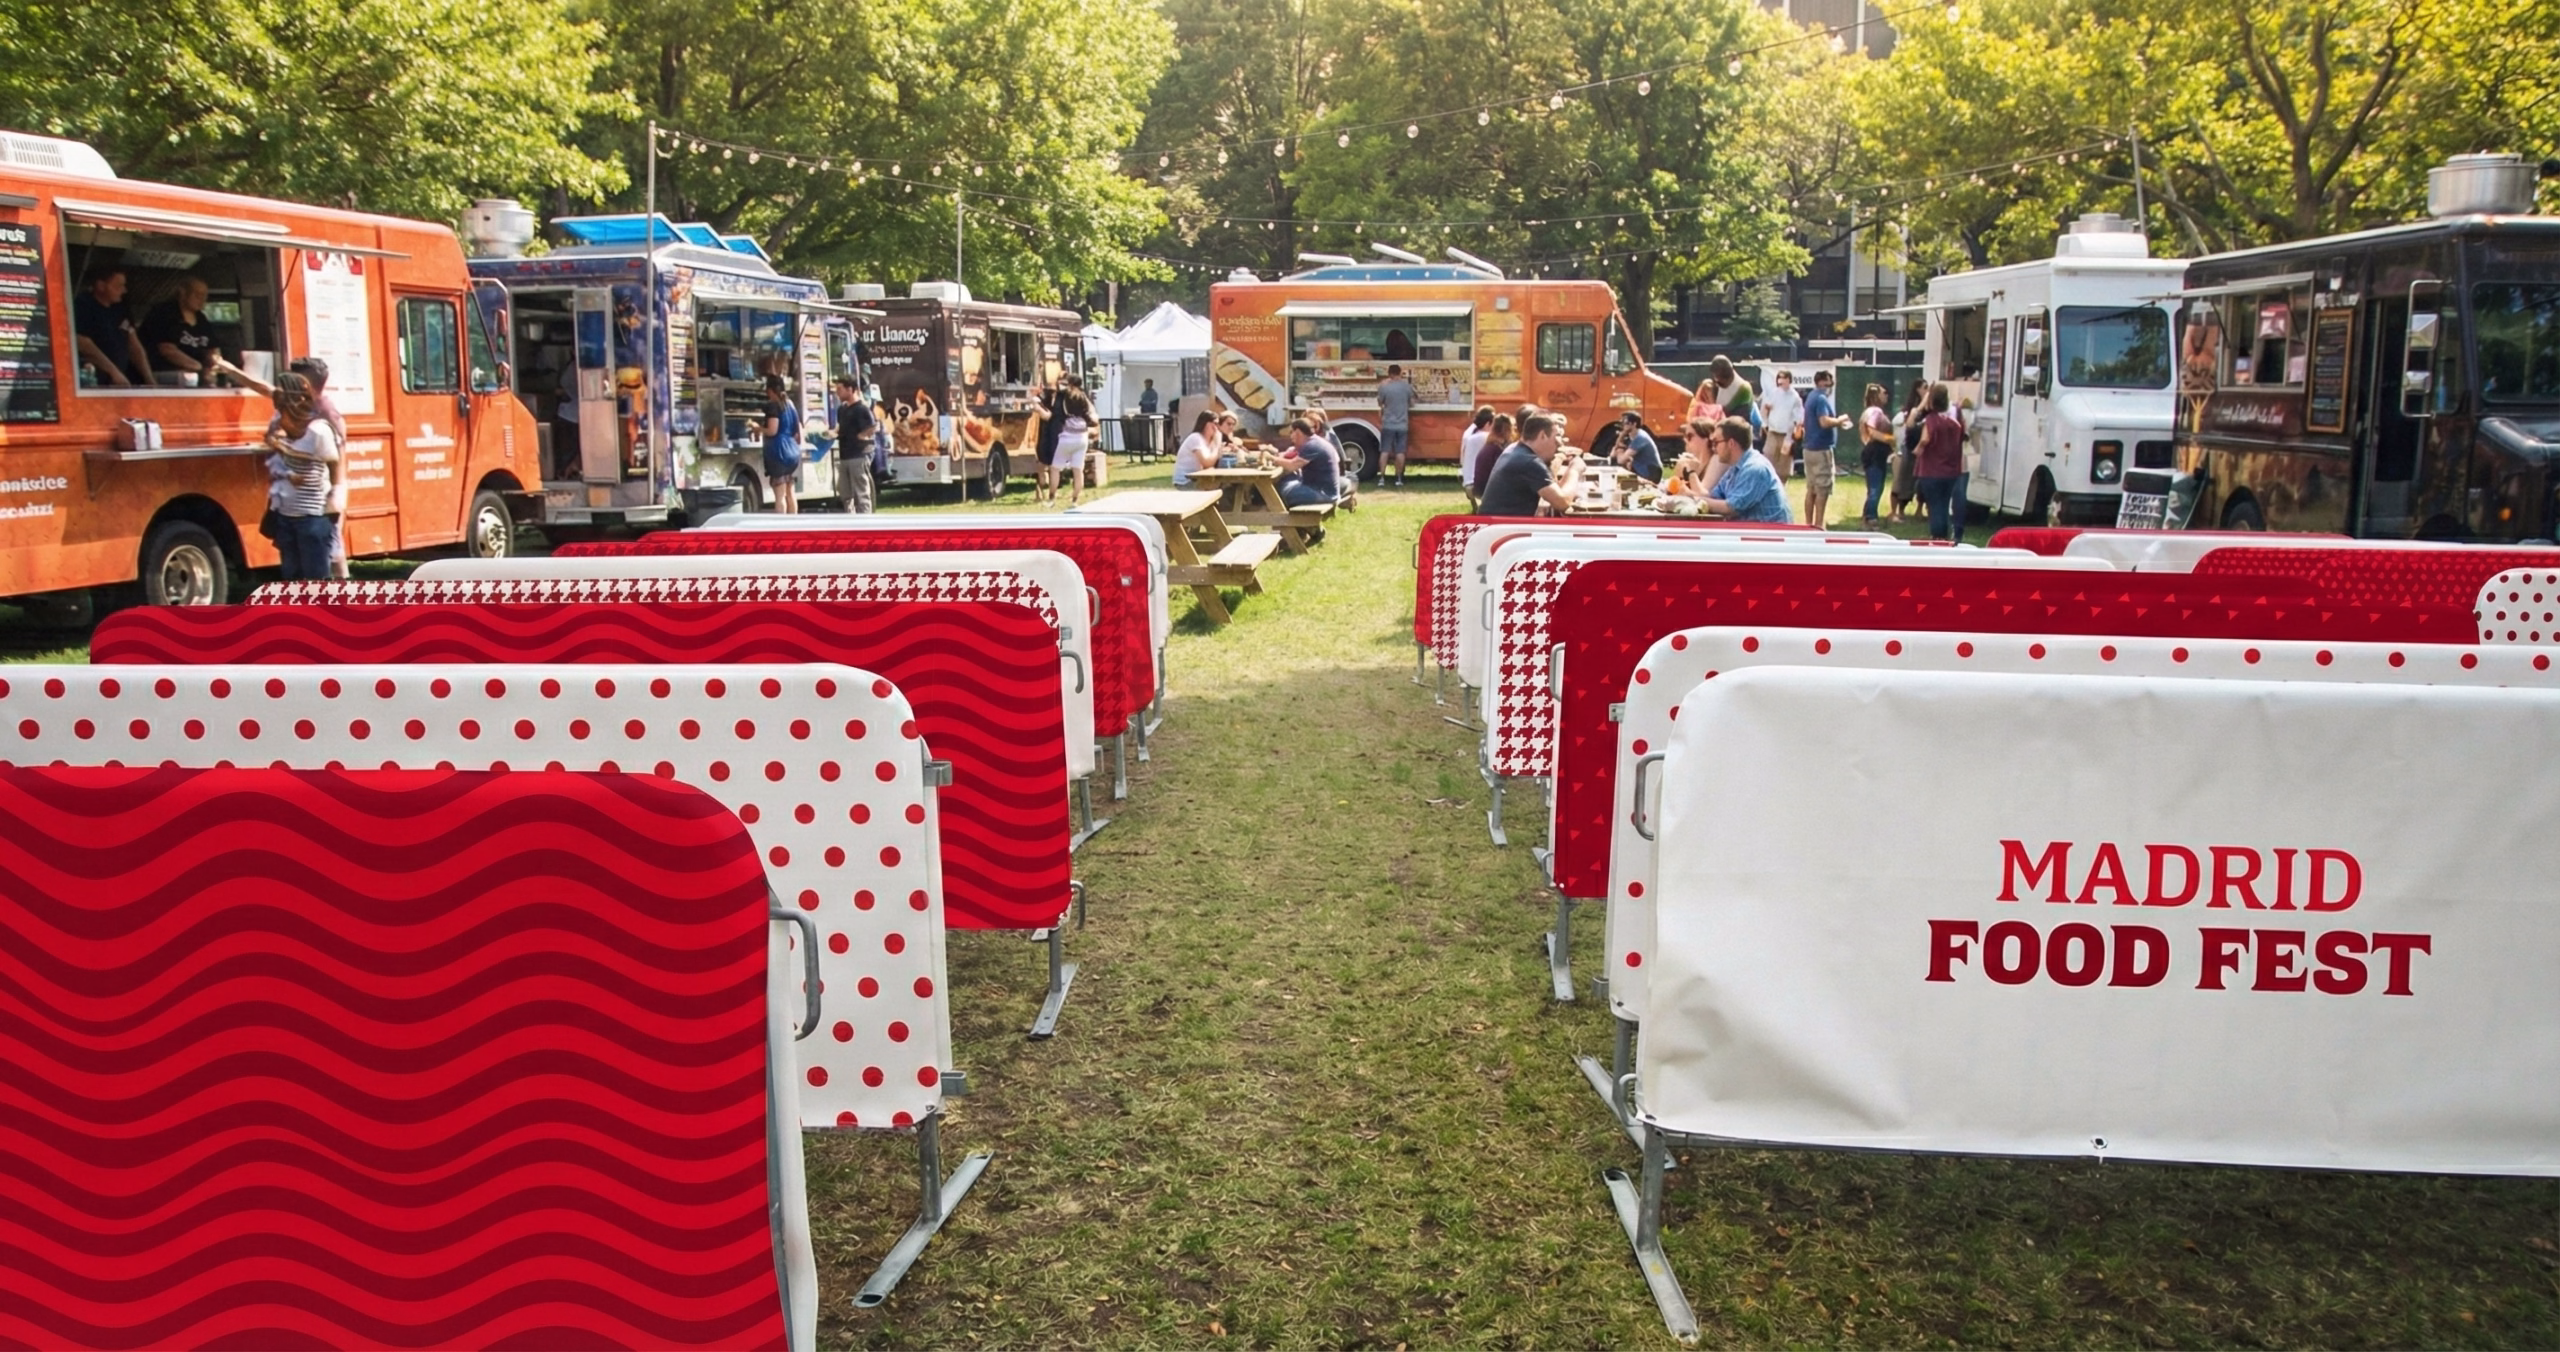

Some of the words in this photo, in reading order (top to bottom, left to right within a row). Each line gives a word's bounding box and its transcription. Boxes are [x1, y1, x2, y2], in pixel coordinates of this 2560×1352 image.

[1998, 839, 2365, 912] MADRID
[1926, 919, 2171, 987] FOOD
[2196, 927, 2433, 997] FEST
